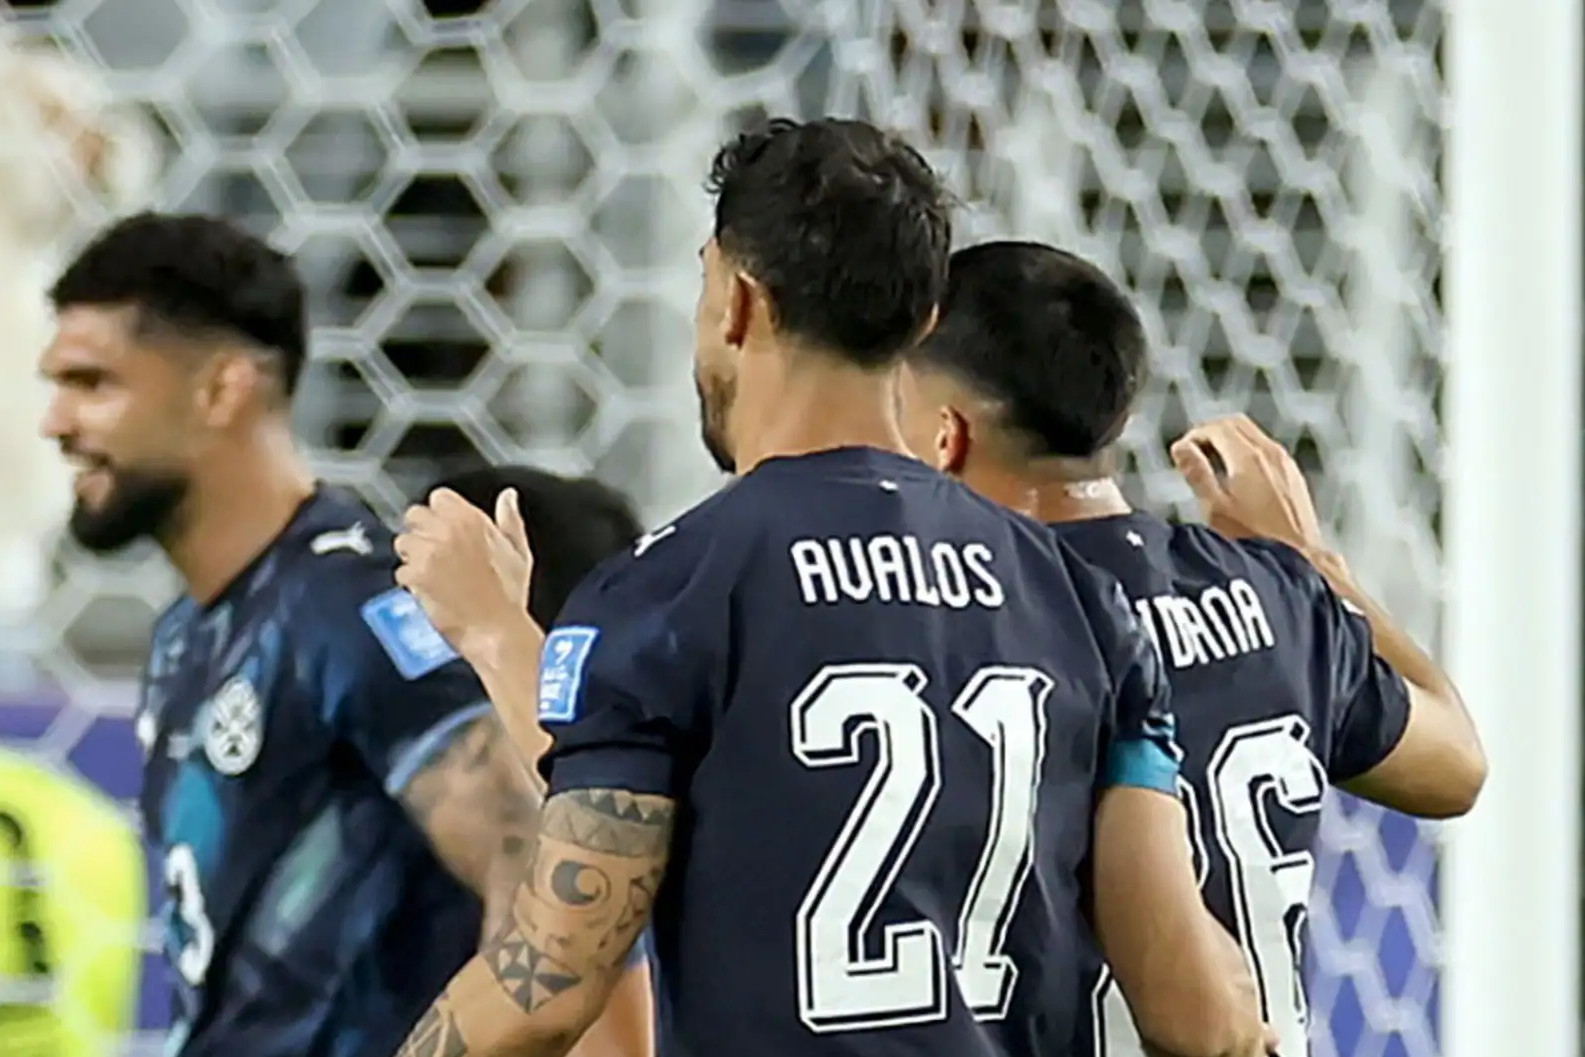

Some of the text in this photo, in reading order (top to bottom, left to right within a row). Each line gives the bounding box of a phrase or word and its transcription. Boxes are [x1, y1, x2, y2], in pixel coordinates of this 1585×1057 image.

[791, 534, 1005, 609] AVALOS
[165, 843, 215, 987] 3
[790, 663, 1056, 1035] 21
